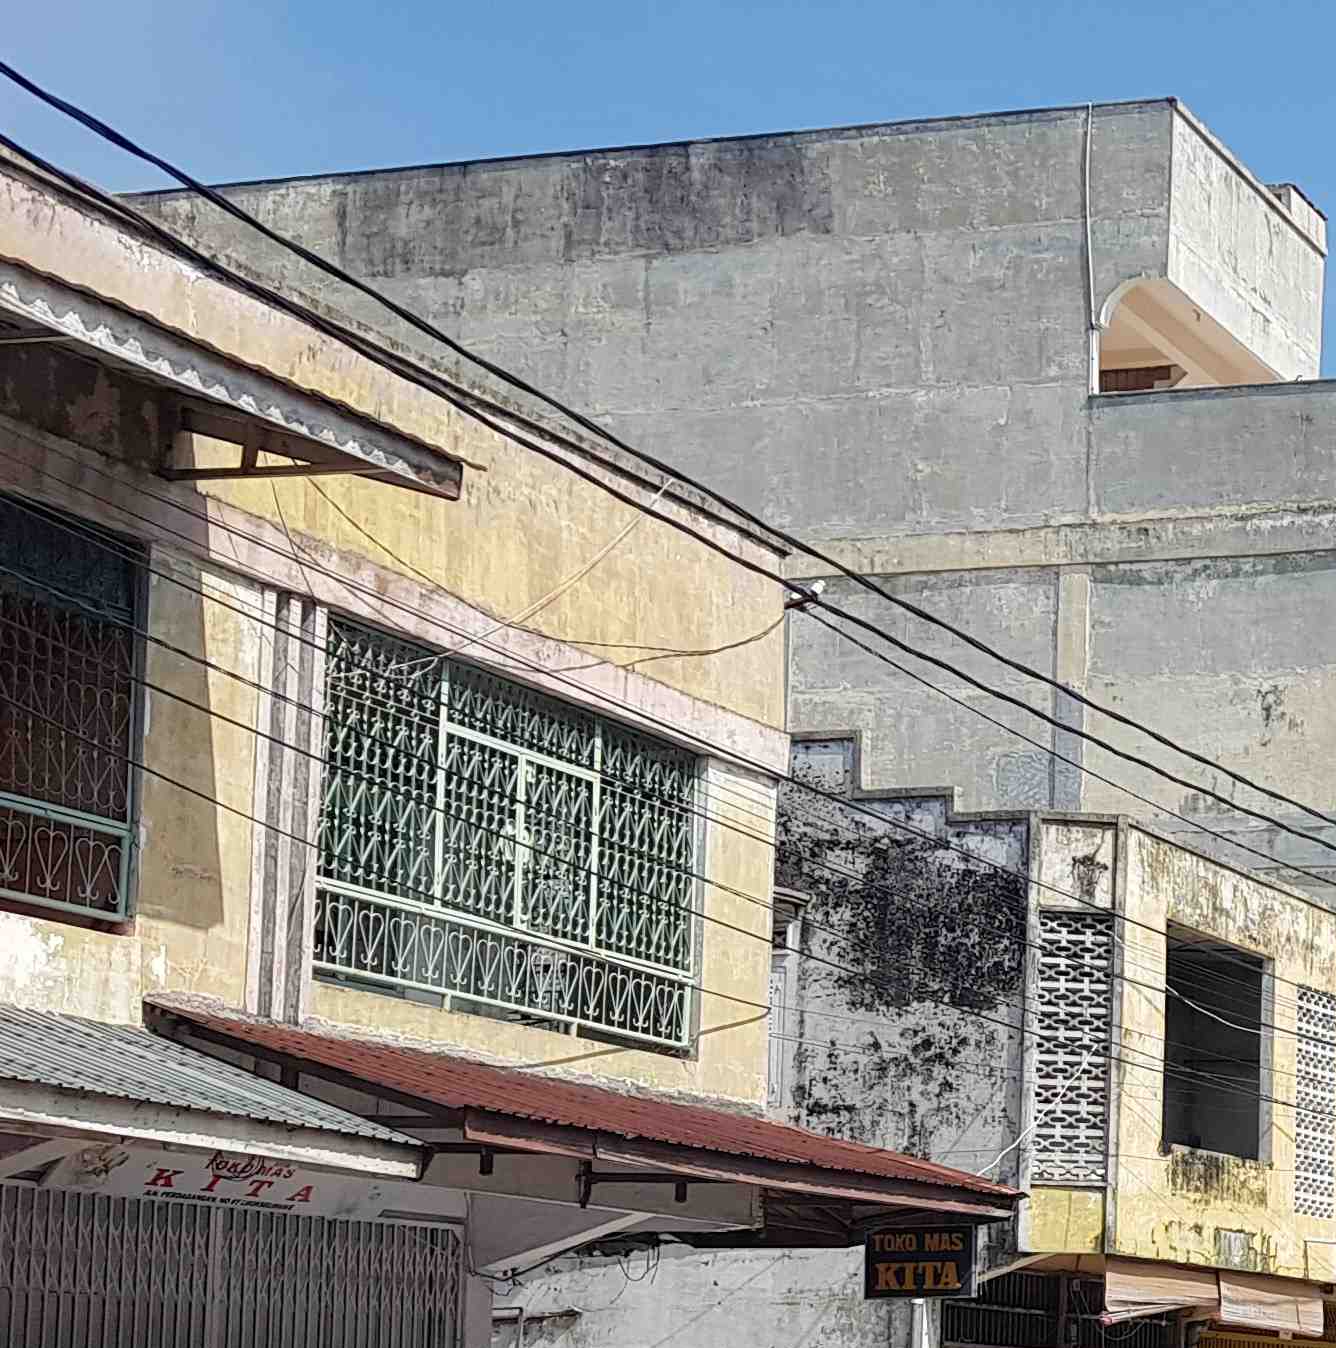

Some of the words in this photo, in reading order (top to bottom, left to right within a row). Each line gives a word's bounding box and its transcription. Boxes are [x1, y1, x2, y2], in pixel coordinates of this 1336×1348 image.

[872, 1234, 916, 1252] TOKO
[924, 1232, 964, 1252] MAS
[874, 1261, 962, 1290] KITA
